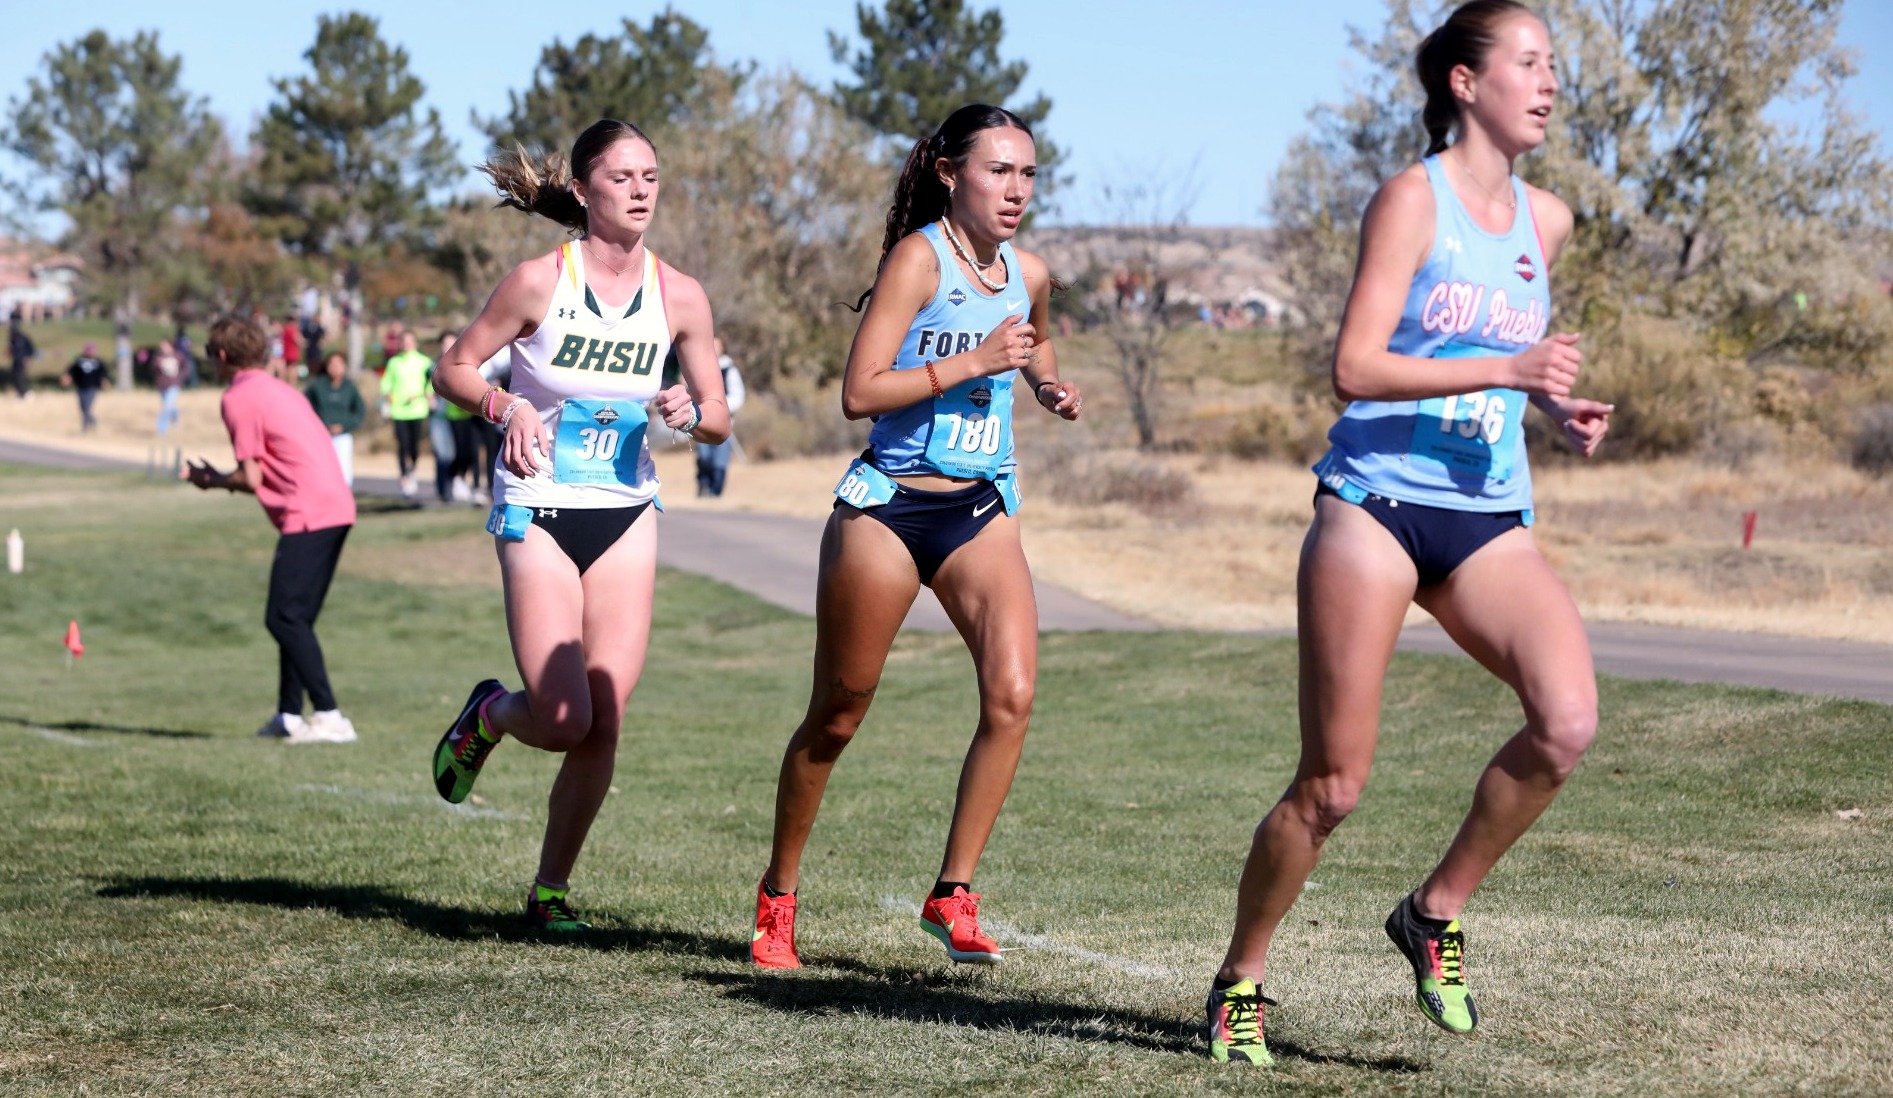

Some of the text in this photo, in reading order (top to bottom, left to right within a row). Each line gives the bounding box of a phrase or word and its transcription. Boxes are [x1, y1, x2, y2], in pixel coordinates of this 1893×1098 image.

[1421, 280, 1485, 335] CSU
[550, 333, 659, 376] BHSU
[946, 411, 1001, 456] 180
[1439, 390, 1506, 446] 136
[576, 427, 620, 462] 30
[837, 473, 870, 506] 80
